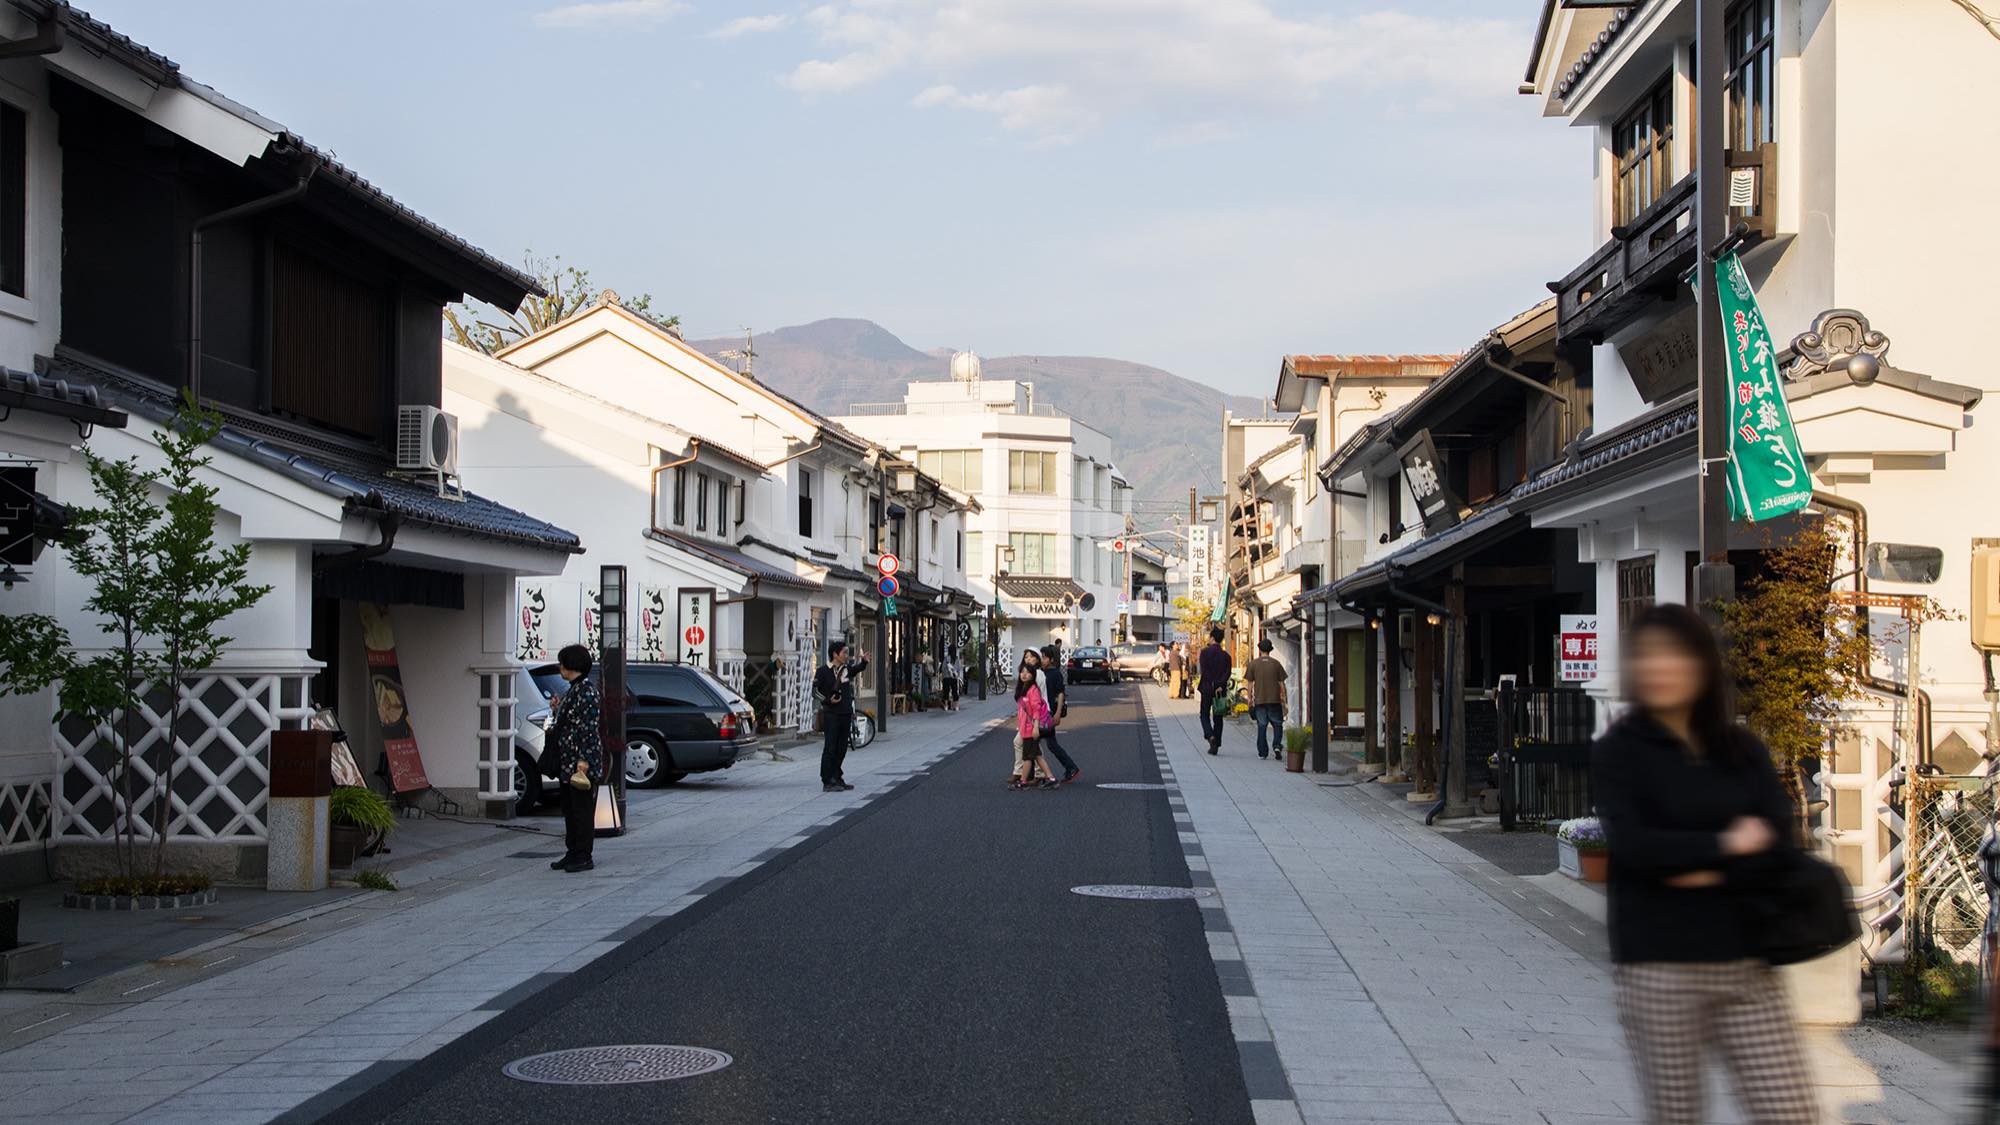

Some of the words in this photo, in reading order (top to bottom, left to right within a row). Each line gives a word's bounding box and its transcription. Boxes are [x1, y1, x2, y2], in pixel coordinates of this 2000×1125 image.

[883, 559, 894, 570] 30
[1192, 546, 1205, 602] 池上医院
[1029, 603, 1072, 614] HAYAMA
[1564, 638, 1597, 656] 専用
